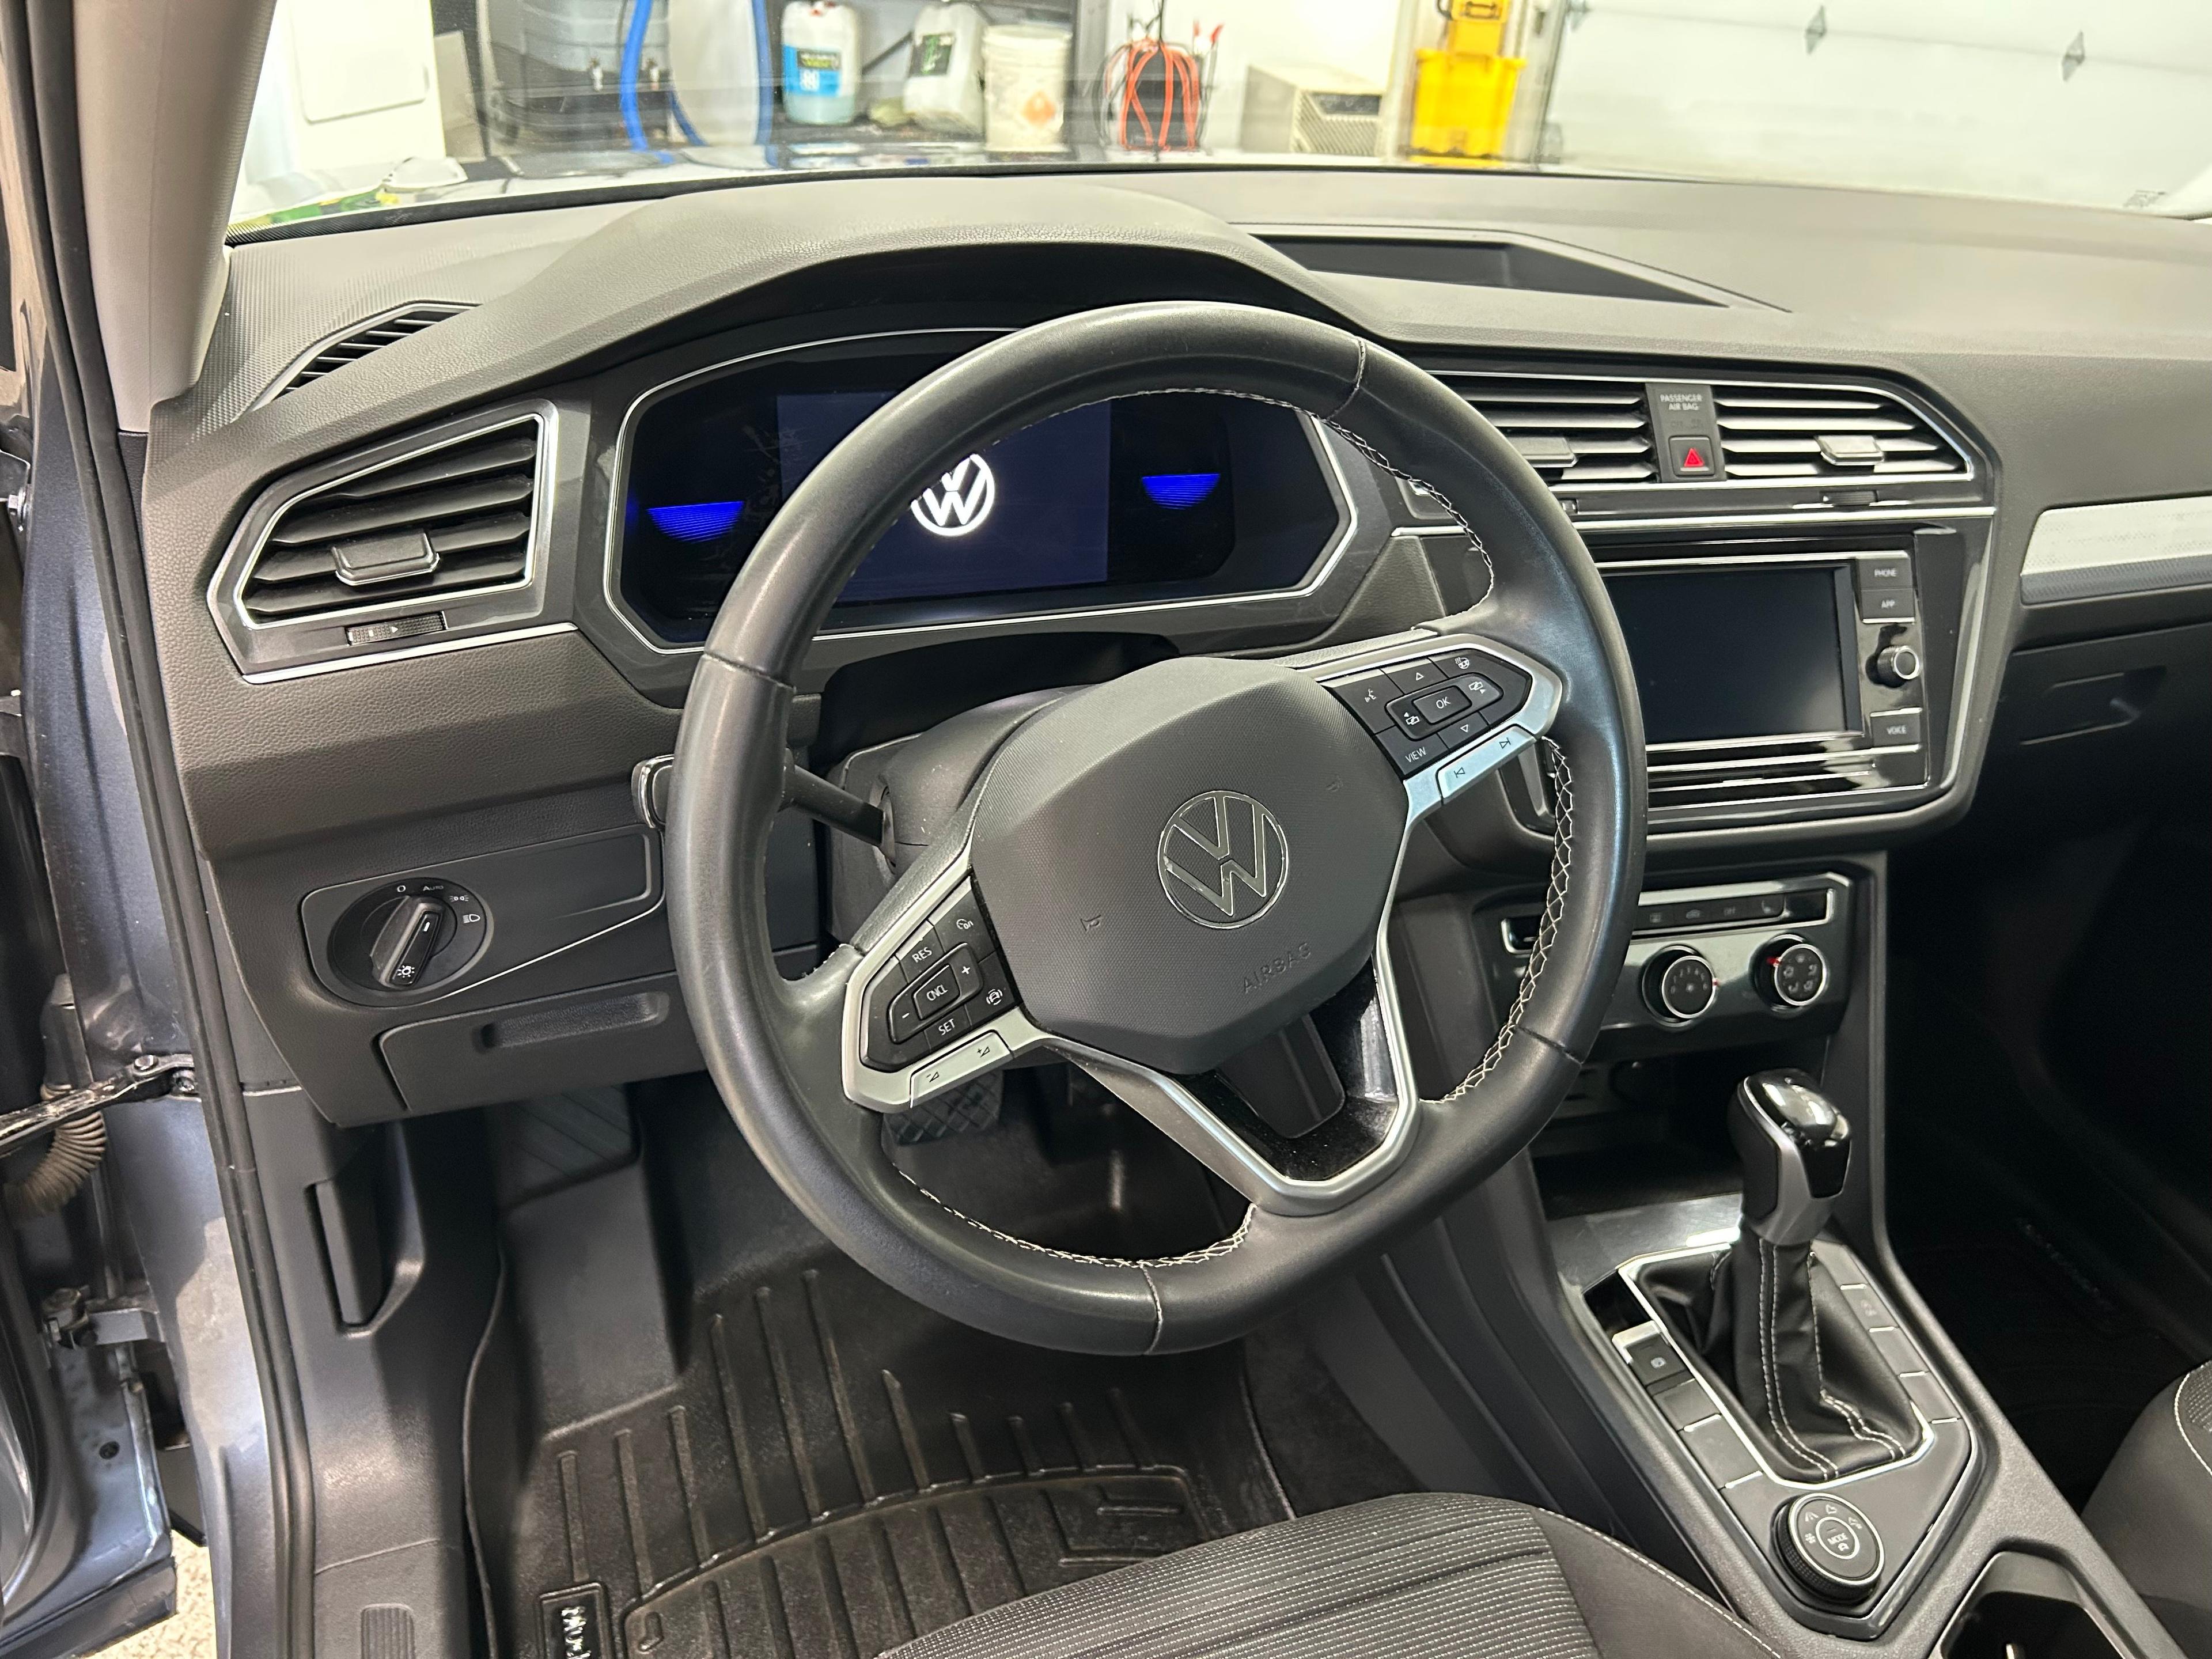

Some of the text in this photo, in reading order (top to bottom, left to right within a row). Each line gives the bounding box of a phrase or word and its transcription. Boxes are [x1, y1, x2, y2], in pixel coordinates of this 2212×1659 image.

[1660, 393, 1703, 402] PASSENGER
[1668, 402, 1681, 410] AIR
[1874, 567, 1897, 577] PHONE
[1881, 599, 1896, 608] APP
[1435, 696, 1452, 709] OK
[1886, 725, 1907, 736] VOICE
[1405, 746, 1426, 763] VIEW
[1159, 791, 1282, 926] VW
[911, 946, 933, 963] RES
[926, 984, 949, 1002] CNCL
[938, 1018, 956, 1036] SET
